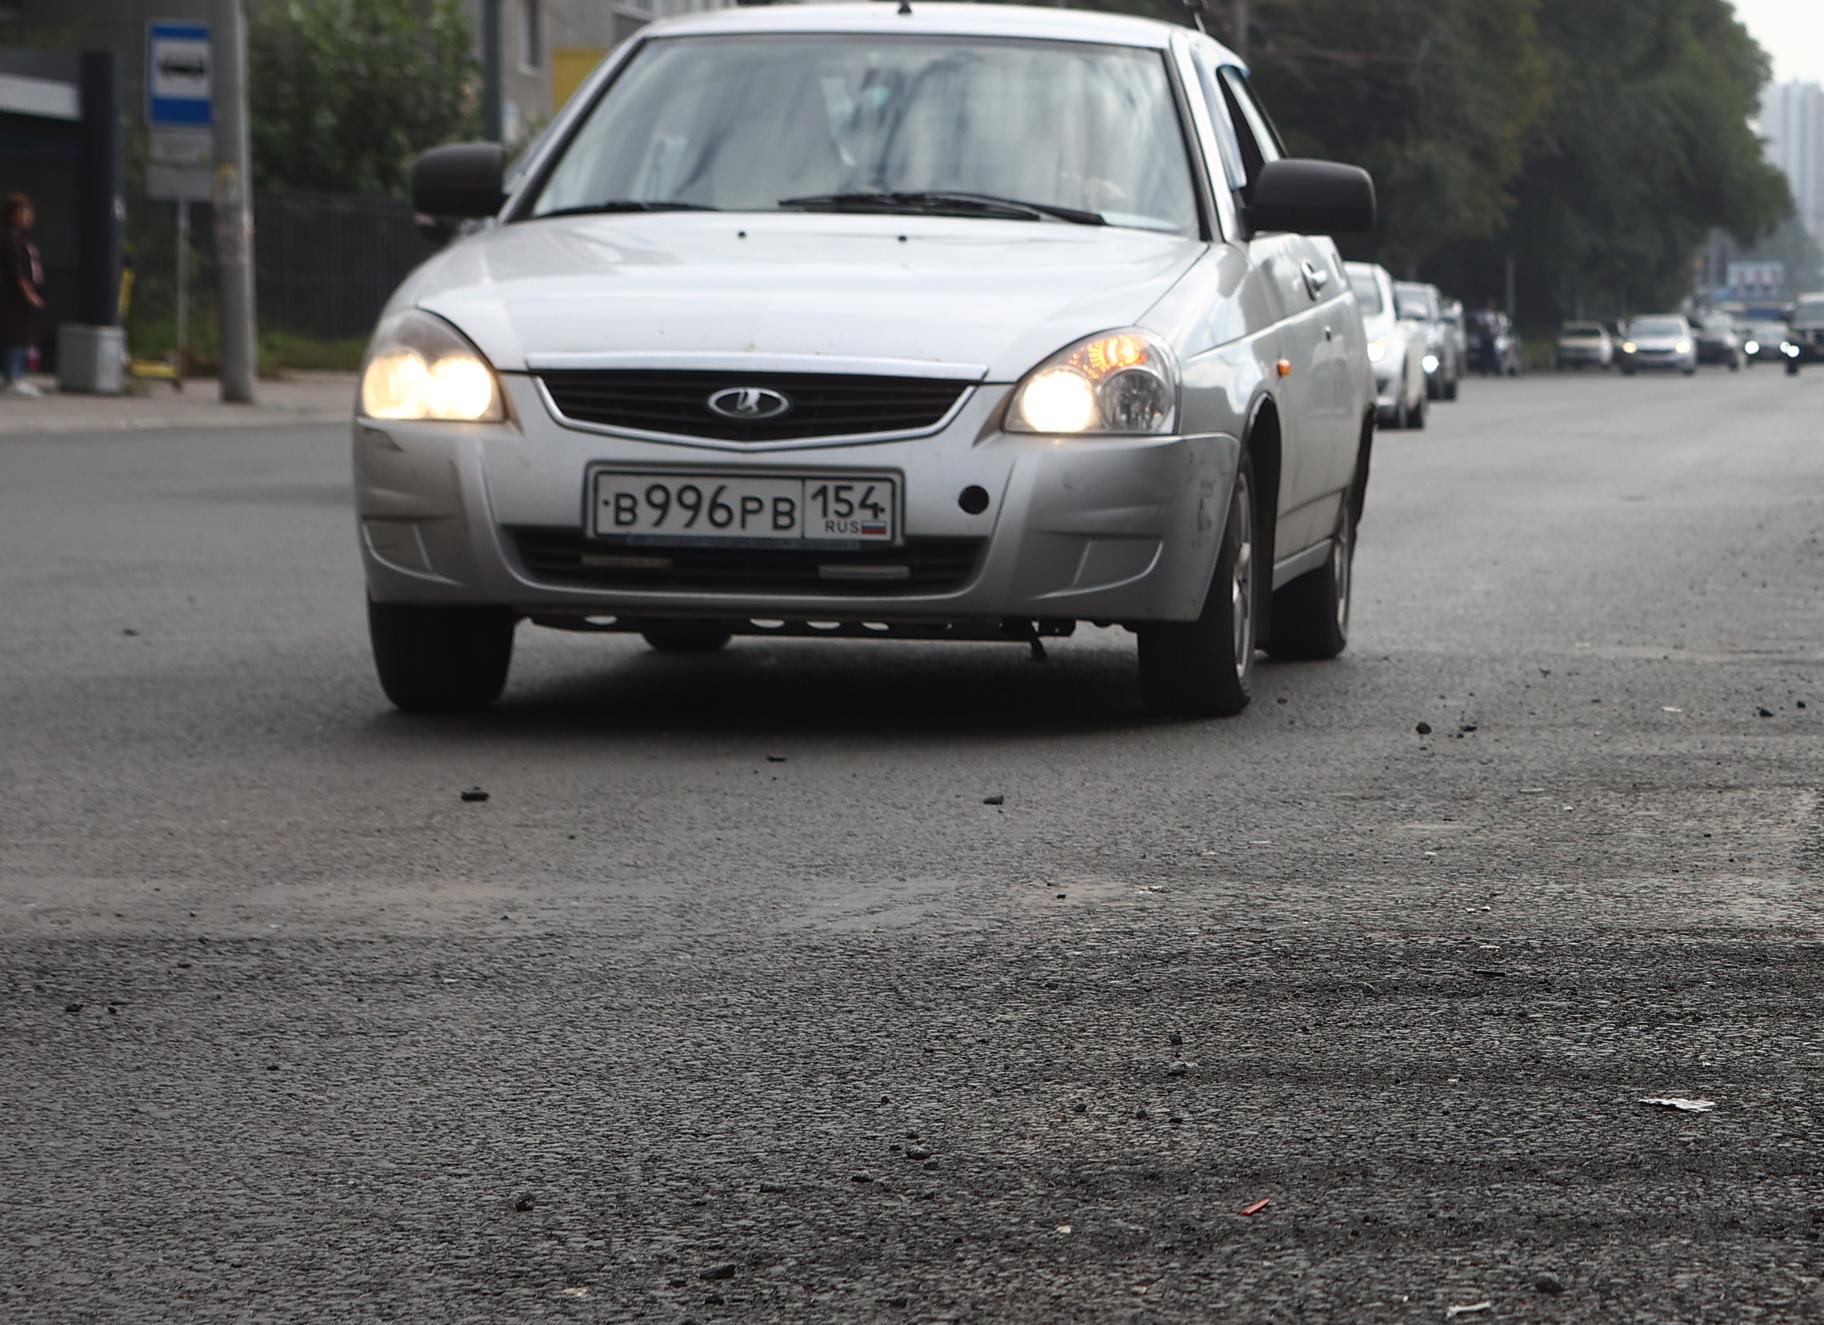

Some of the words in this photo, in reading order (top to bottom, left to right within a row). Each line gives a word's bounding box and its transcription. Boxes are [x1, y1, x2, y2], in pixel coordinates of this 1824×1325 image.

[614, 484, 797, 531] В996РВ
[812, 485, 885, 520] 154
[824, 520, 861, 533] RUS
